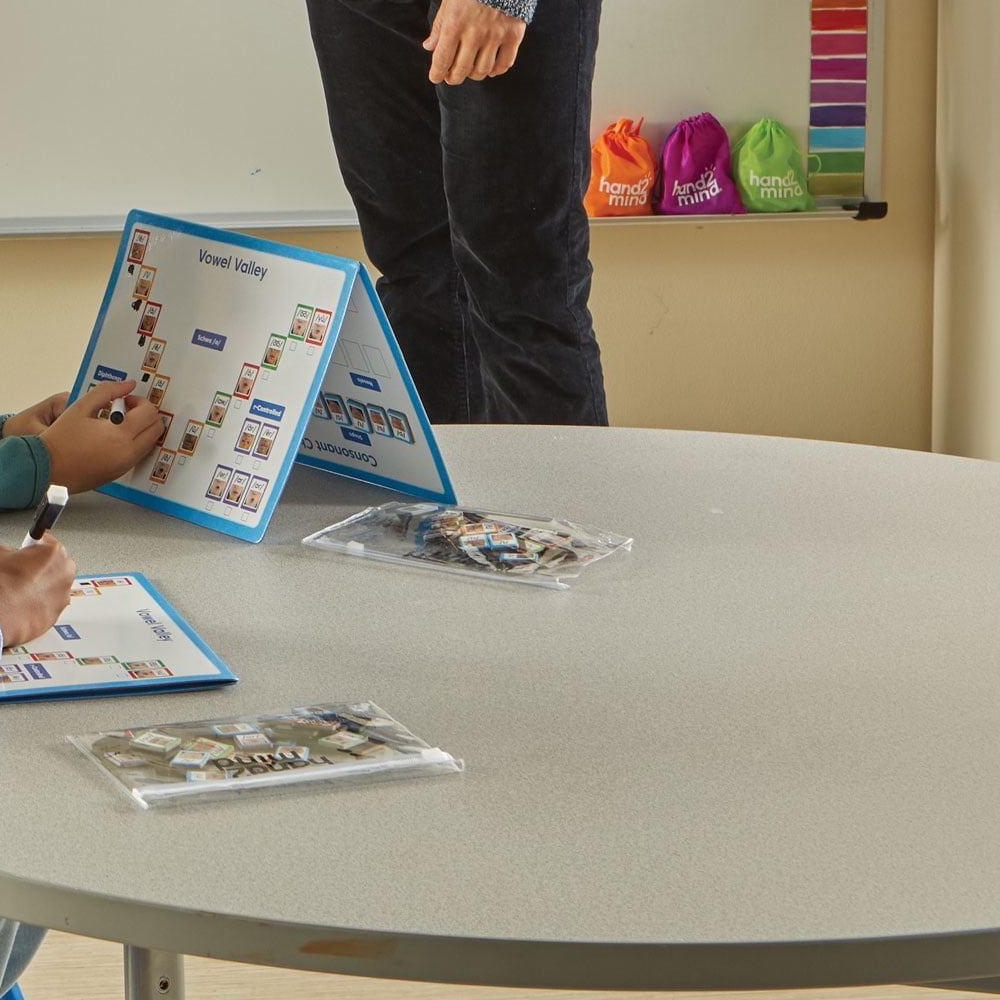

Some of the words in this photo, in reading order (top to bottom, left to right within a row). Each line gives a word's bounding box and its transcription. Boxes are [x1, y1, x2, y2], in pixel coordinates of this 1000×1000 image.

[599, 176, 649, 195] hand2
[672, 171, 714, 196] hand2
[678, 178, 720, 207] mind
[199, 249, 232, 269] Vowel
[235, 257, 268, 281] Valley
[316, 440, 378, 467] Consonant
